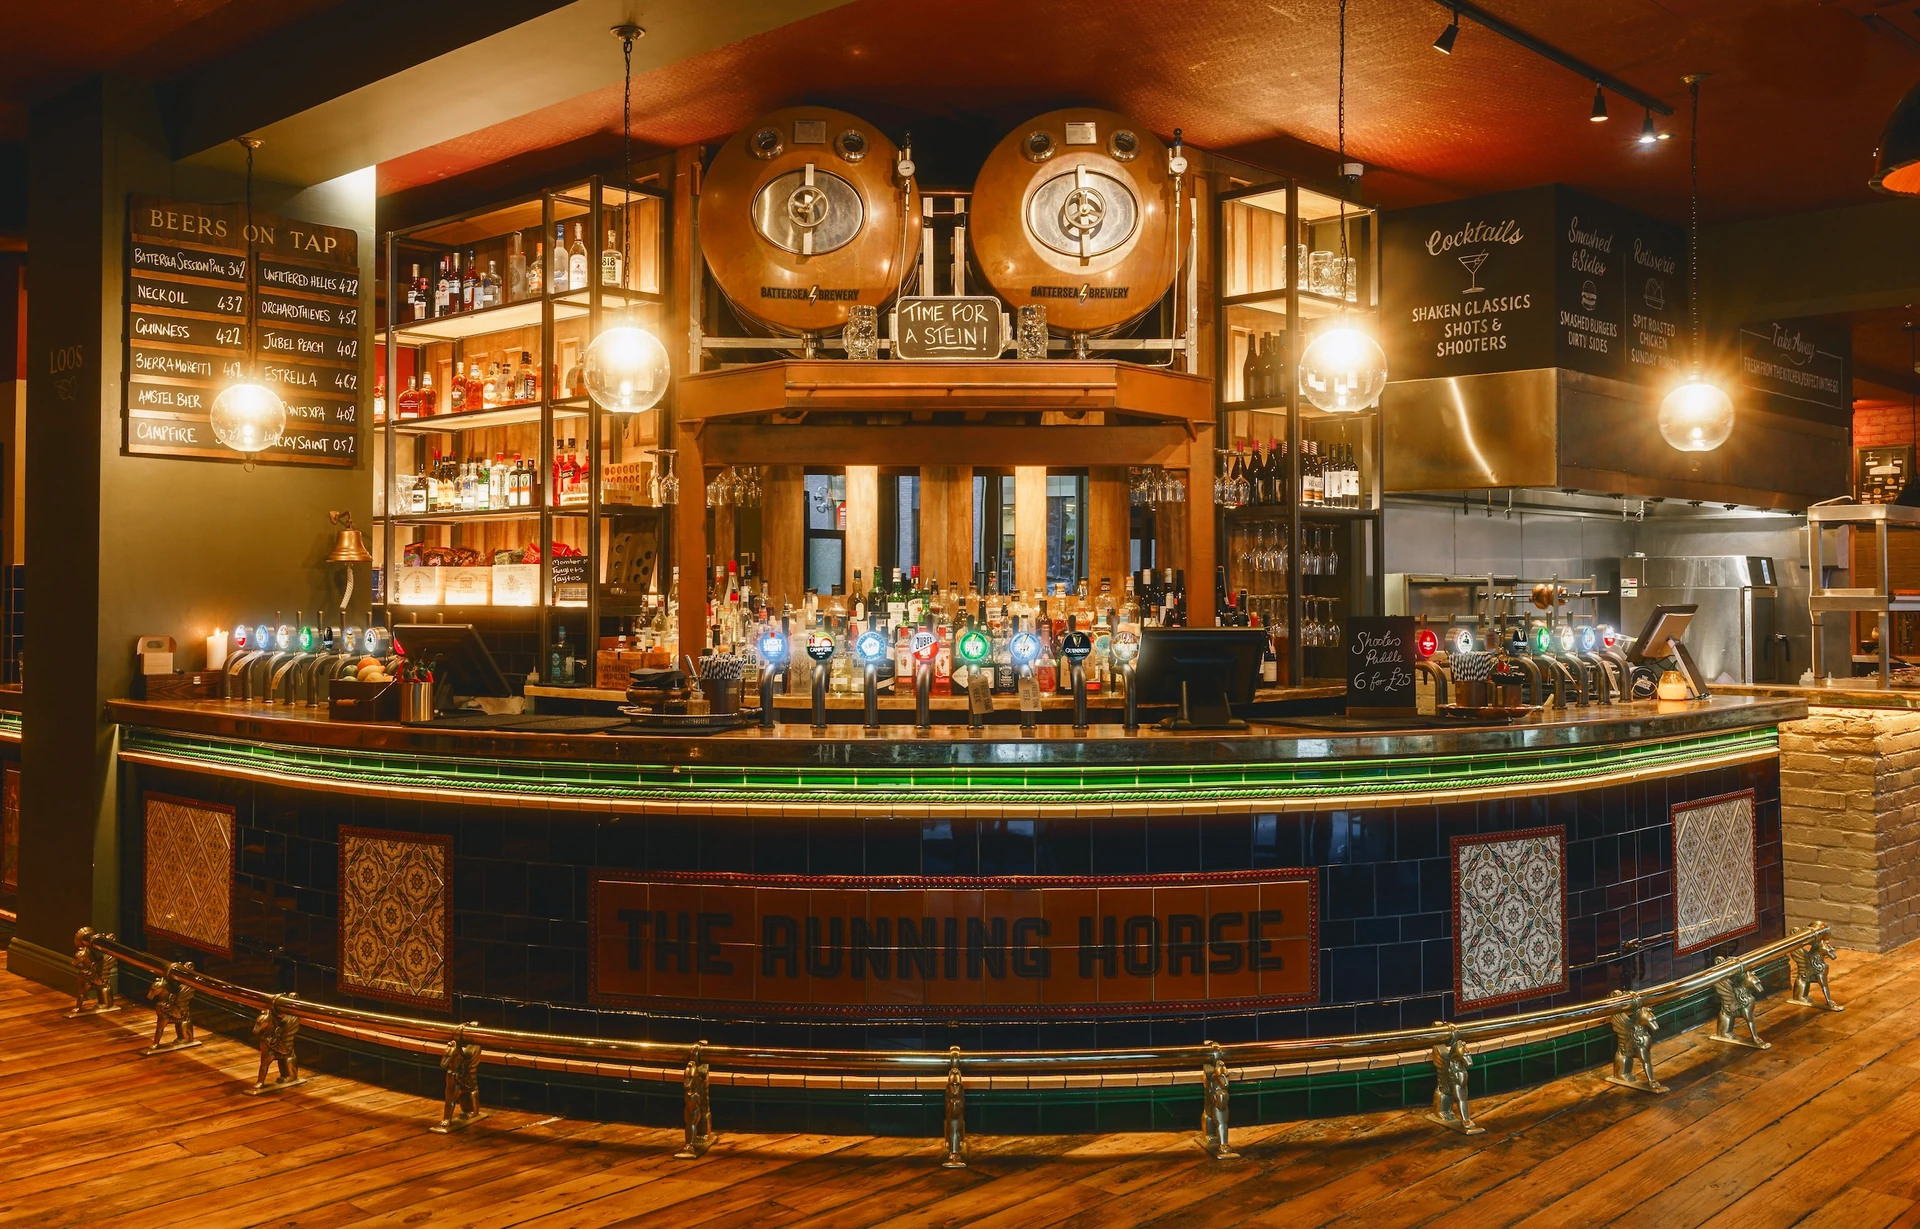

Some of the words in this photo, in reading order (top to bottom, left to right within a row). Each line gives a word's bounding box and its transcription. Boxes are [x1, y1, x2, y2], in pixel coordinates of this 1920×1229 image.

[151, 209, 227, 238] BEERS
[243, 224, 275, 245] ON
[290, 230, 337, 254] TAP
[1425, 219, 1525, 256] Cocktails
[1568, 216, 1614, 254] Smashed
[209, 258, 225, 275] PALE
[1633, 238, 1676, 275] Rotisserie
[263, 268, 308, 287] UNFILTERED
[310, 276, 337, 290] HELLES
[137, 284, 167, 301] NECK
[169, 290, 189, 305] OIL
[761, 286, 808, 299] BATTERSEA
[818, 288, 860, 301] BREWERY
[1031, 286, 1079, 298] BATTERSEA
[1089, 287, 1129, 299] BREWERY
[902, 301, 944, 322] TIME
[952, 303, 988, 323] FOR
[1412, 303, 1461, 323] SHAKEN
[1464, 294, 1531, 316] CLASSICS
[135, 317, 190, 339] GUINNESS
[1444, 319, 1488, 338] SHOTS
[1491, 318, 1502, 332] &
[1560, 310, 1590, 332] SMASHED
[1590, 314, 1618, 338] BURGERS
[1632, 313, 1648, 329] SPIT
[1649, 317, 1676, 337] ROASTED
[263, 332, 295, 350] JUBEL
[297, 338, 324, 354] PEACH
[905, 327, 918, 344] A
[1437, 335, 1507, 358] SHOOTERS
[1568, 331, 1587, 349] DIRTY
[1588, 334, 1608, 354] SIDES
[1639, 331, 1668, 350] CHICKEN
[1771, 322, 1792, 351] Take
[49, 345, 83, 374] LOOS
[1631, 348, 1658, 367] SUNDAY
[1658, 354, 1680, 372] ROASTS
[1743, 356, 1761, 374] FRESH
[1760, 361, 1773, 378] FROM
[1773, 364, 1783, 380] THE
[264, 366, 318, 387] ESTRELLA
[138, 389, 174, 406] AMSTEL
[176, 392, 202, 409] BIER
[309, 405, 326, 421] XPA
[137, 422, 198, 444] CAMPFIRE
[297, 435, 330, 453] SAINT
[915, 636, 933, 650] JUBEL
[1352, 630, 1401, 655] Shooters
[1365, 649, 1404, 667] Paddle
[1354, 672, 1366, 690] 6
[1370, 671, 1387, 691] for
[1385, 667, 1412, 692] £25
[616, 908, 735, 975] THE
[760, 914, 1052, 981] RUNNING
[1077, 908, 1285, 979] HORSE
